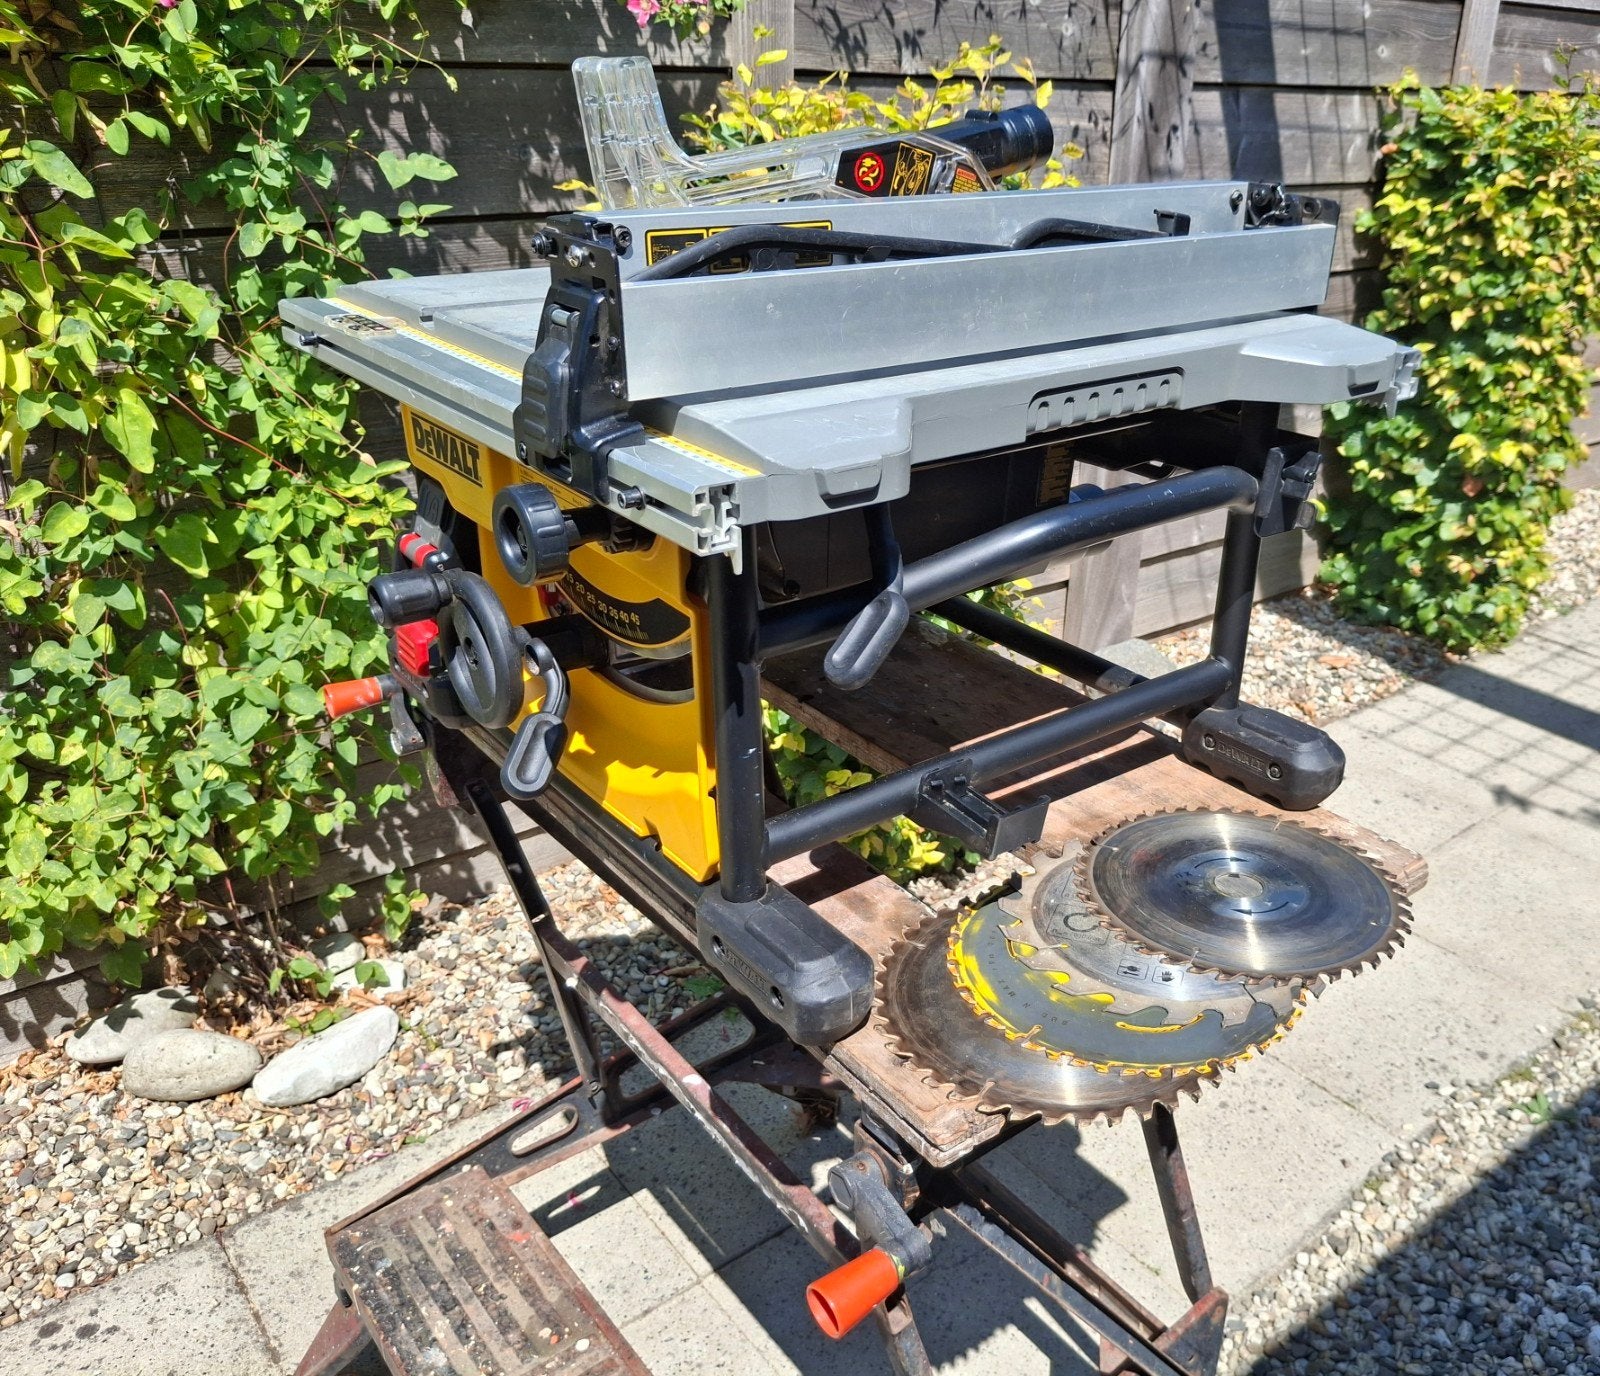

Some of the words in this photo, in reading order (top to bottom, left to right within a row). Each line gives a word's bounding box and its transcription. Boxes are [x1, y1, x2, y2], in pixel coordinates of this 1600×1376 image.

[575, 581, 585, 594] 20
[586, 592, 597, 604] 25
[608, 606, 619, 619] 35
[619, 610, 630, 623] 40
[630, 612, 640, 625] 45
